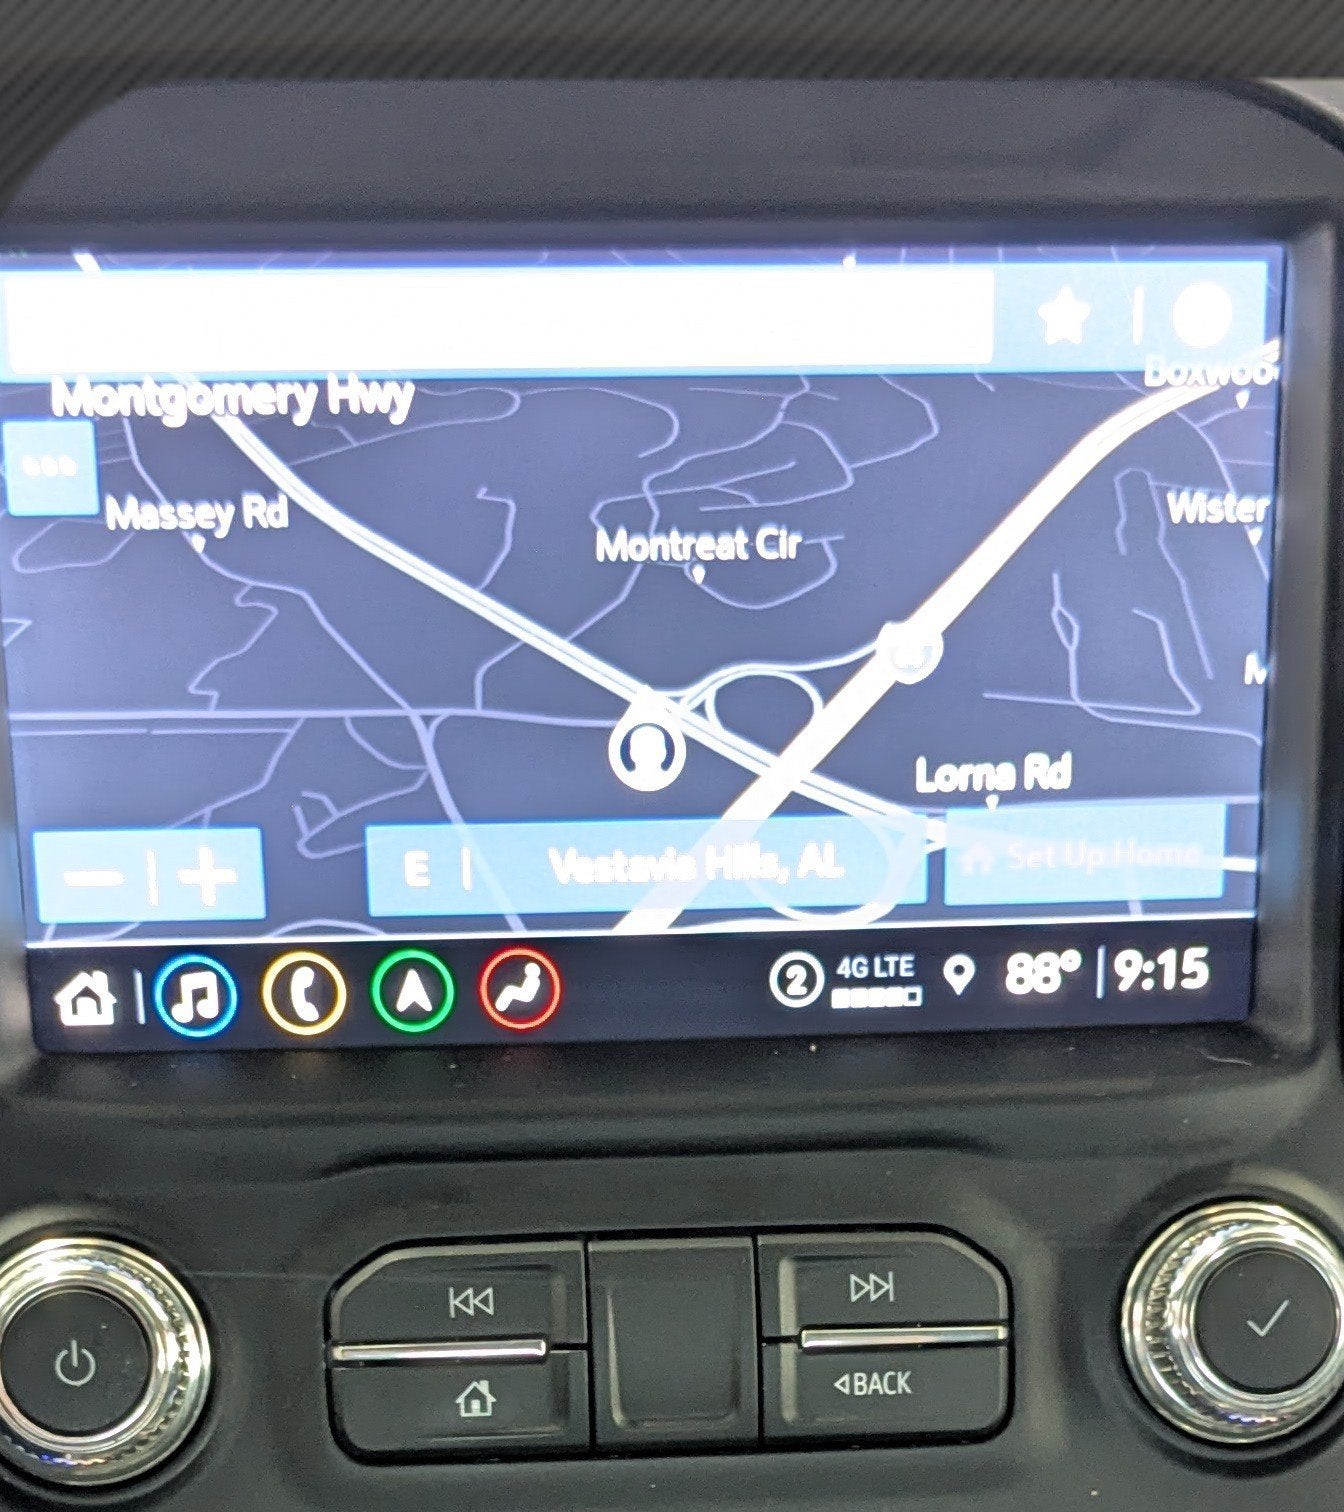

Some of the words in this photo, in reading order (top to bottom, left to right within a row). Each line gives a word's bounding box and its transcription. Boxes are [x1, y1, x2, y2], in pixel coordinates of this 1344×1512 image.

[50, 376, 318, 429] Montgomery
[327, 372, 415, 426] Hwy
[105, 495, 234, 539] Massey
[243, 492, 289, 530] Rd
[1167, 489, 1270, 525] Wister
[595, 526, 749, 563] Montreat
[755, 523, 802, 559] Cir
[915, 754, 1016, 795] Lorna
[1024, 750, 1073, 791] Rd
[404, 850, 430, 888] E
[798, 840, 846, 879] AL
[785, 964, 808, 996] 2
[836, 956, 870, 979] 4G
[873, 953, 915, 978] LTE
[1113, 945, 1211, 993] 9:15
[853, 1372, 911, 1396] BACK
